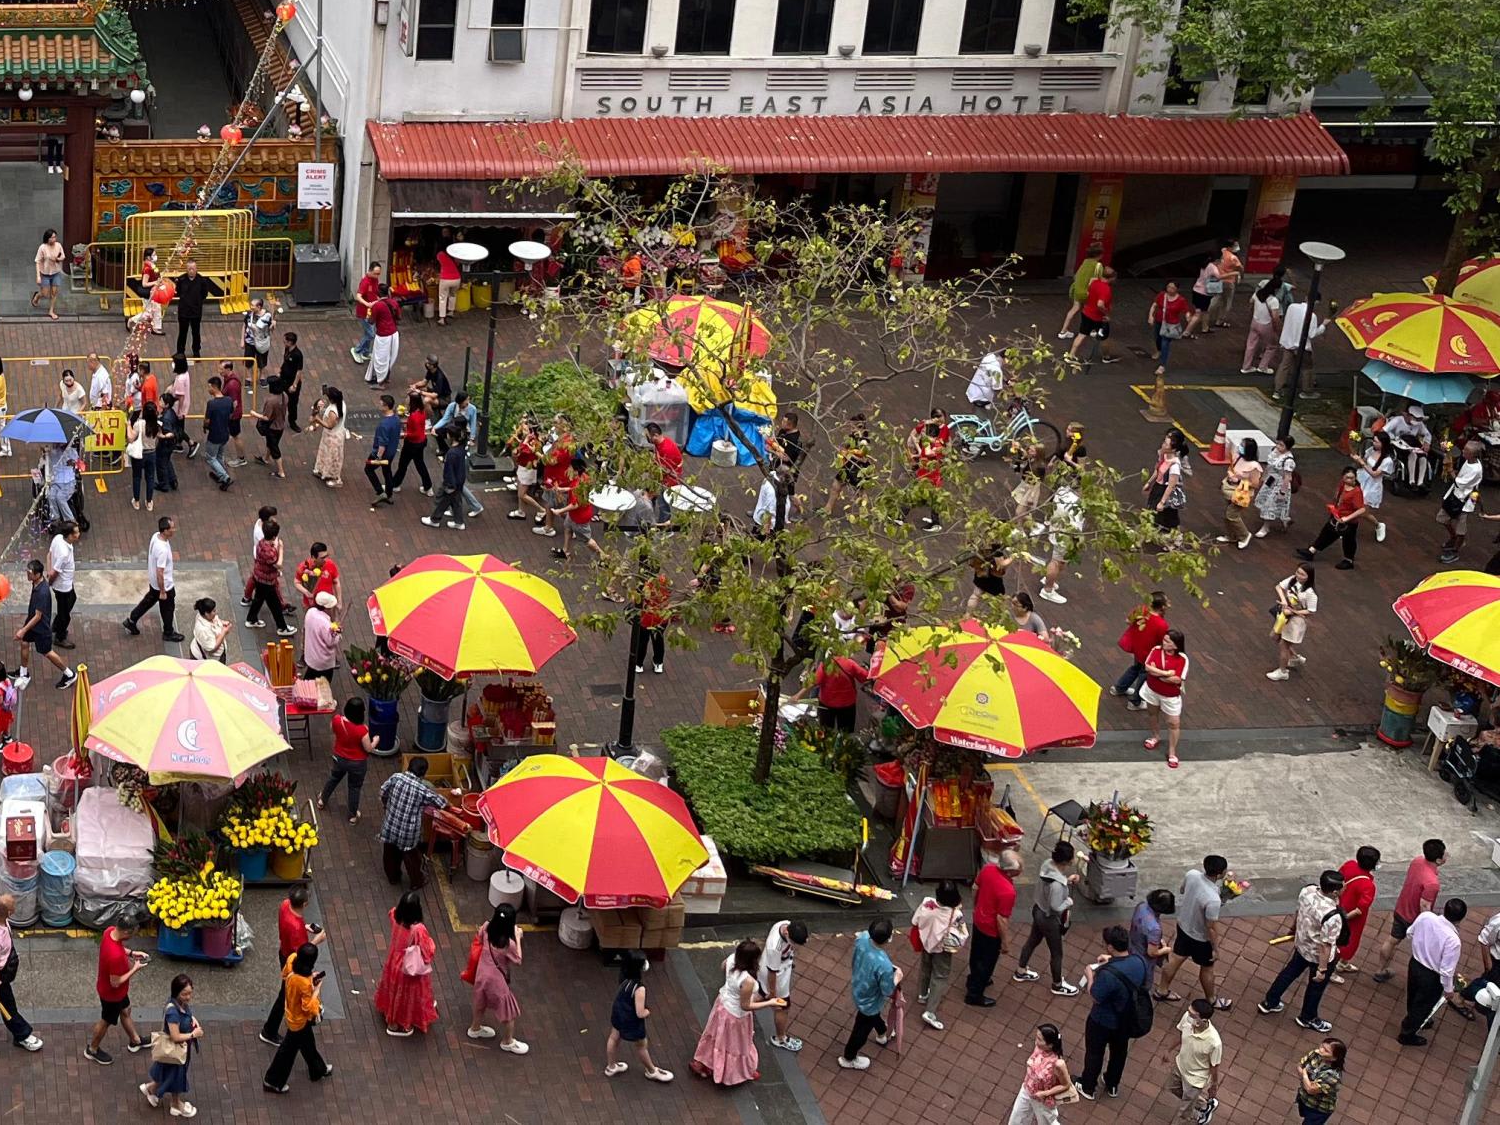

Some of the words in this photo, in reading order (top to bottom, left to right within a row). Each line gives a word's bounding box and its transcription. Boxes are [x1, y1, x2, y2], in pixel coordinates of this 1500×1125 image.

[596, 96, 713, 114] SOUTH
[739, 96, 828, 114] EAST
[856, 95, 933, 114] ASIA
[960, 95, 1076, 114] HOTEL
[93, 418, 119, 429] 入口
[96, 433, 115, 446] IN
[950, 735, 987, 750] Waterloo
[988, 743, 1007, 755] Mall
